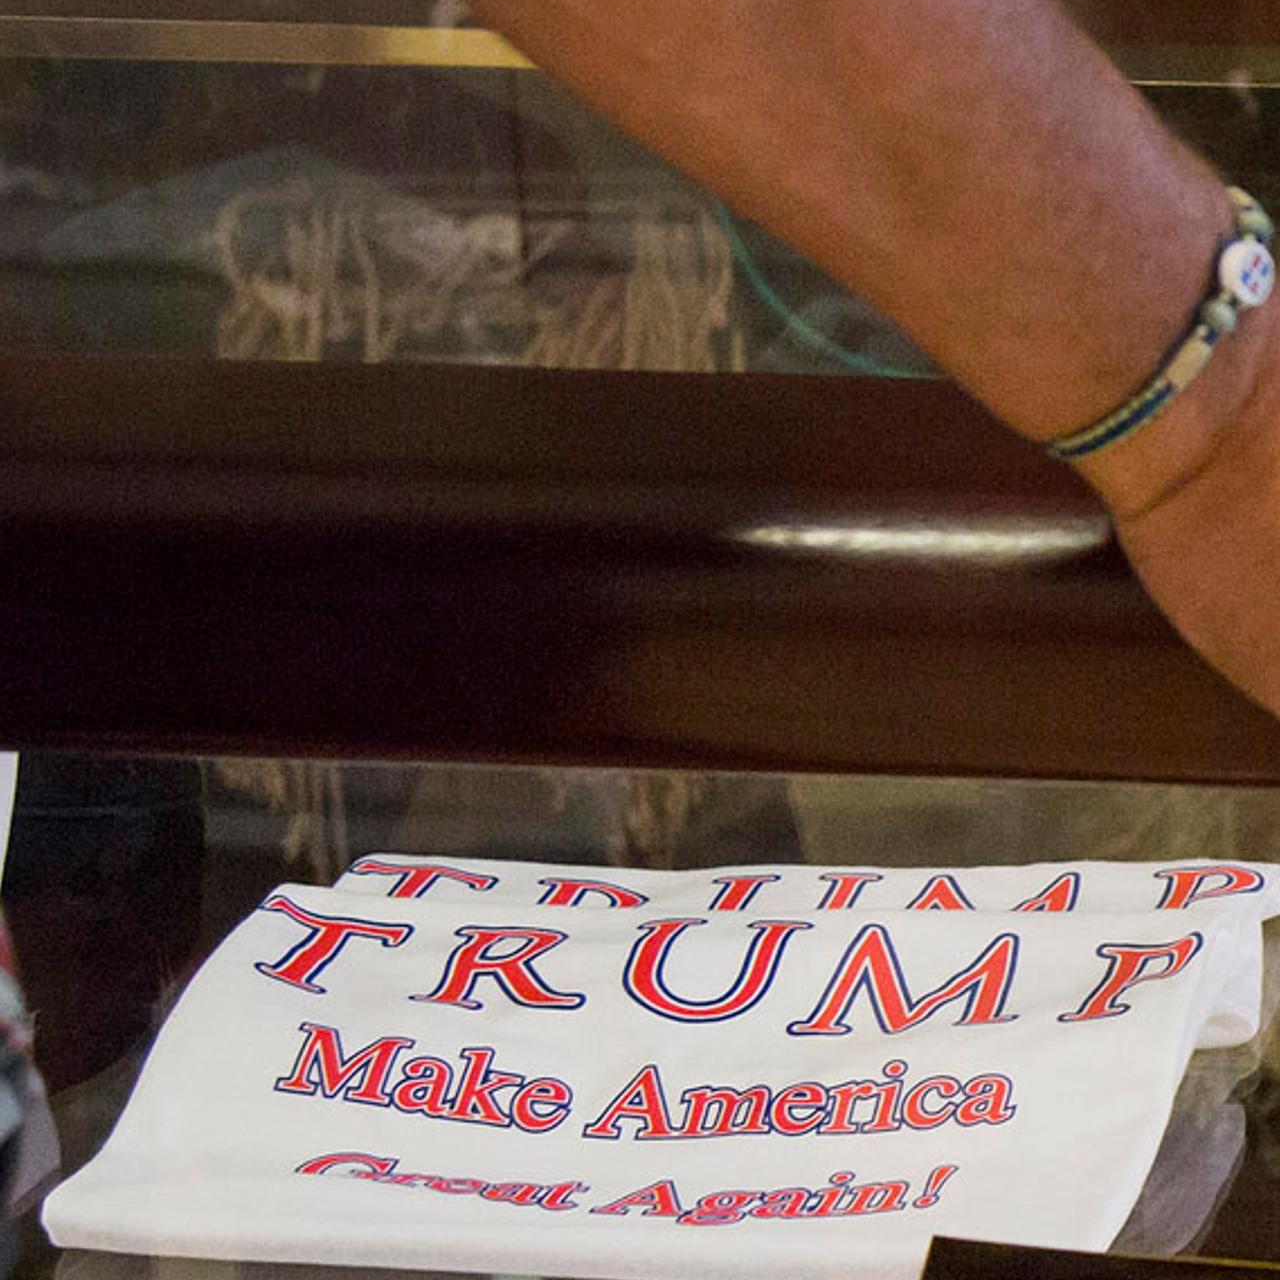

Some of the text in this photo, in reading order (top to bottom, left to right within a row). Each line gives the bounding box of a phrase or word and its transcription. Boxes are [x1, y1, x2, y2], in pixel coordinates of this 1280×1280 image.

[255, 894, 1203, 1036] TRUMP
[273, 1022, 1016, 1140] Make America
[589, 1165, 959, 1225] Again!
